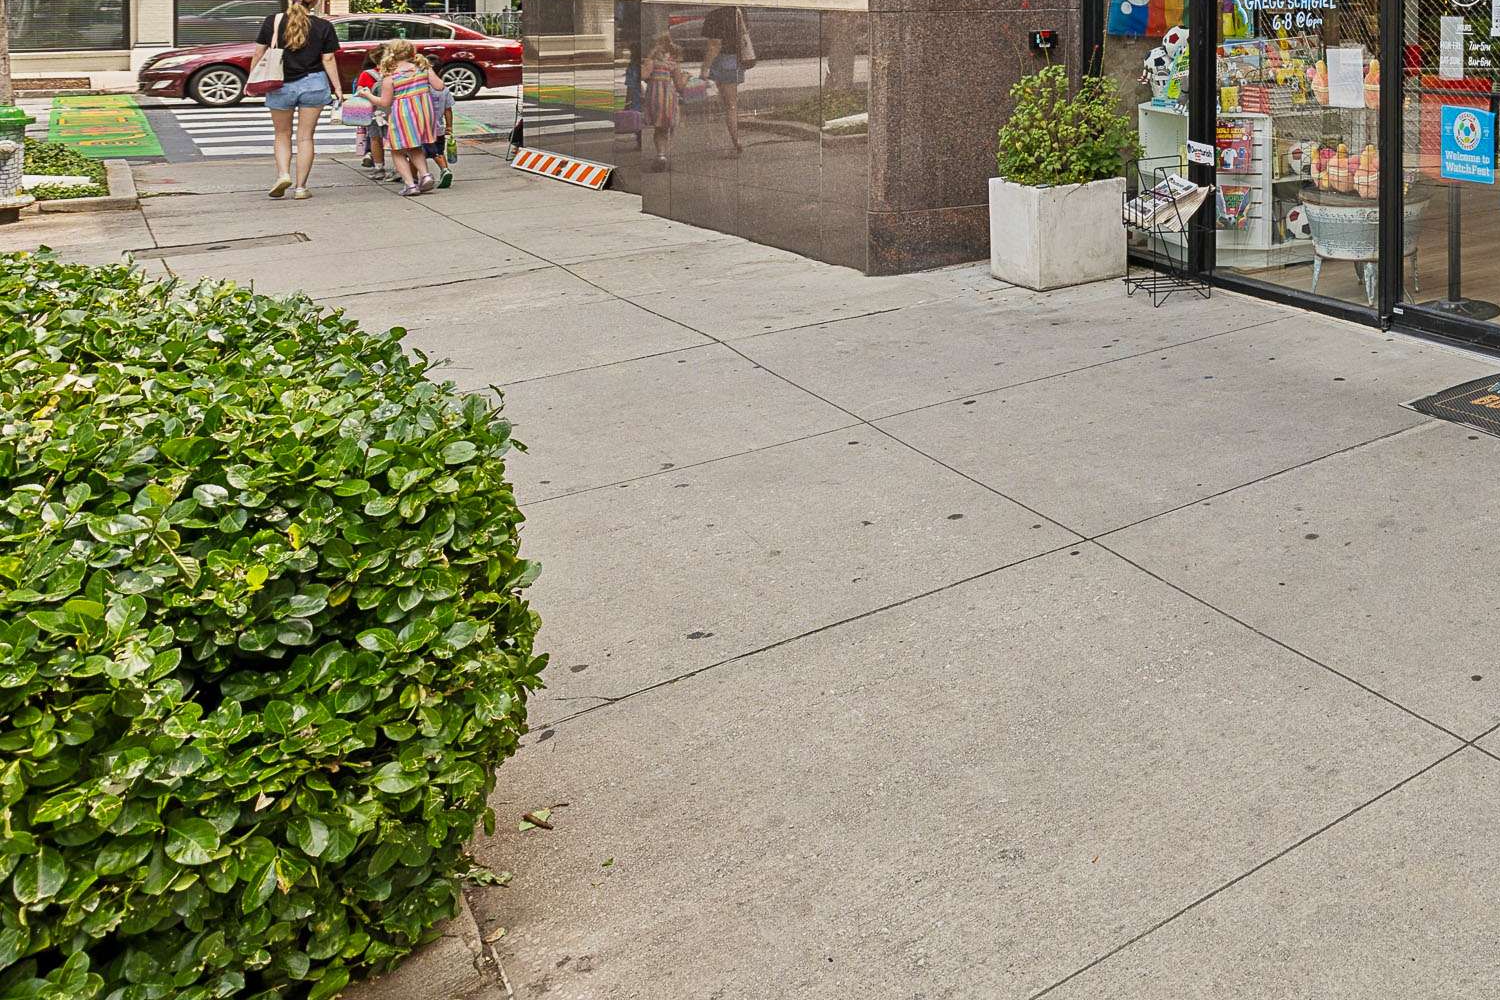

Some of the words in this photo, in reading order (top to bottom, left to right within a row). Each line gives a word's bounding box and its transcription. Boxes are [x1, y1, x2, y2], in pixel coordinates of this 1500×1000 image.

[1445, 150, 1480, 163] Welcome
[1482, 155, 1490, 164] to
[1445, 161, 1490, 177] WatchFest
